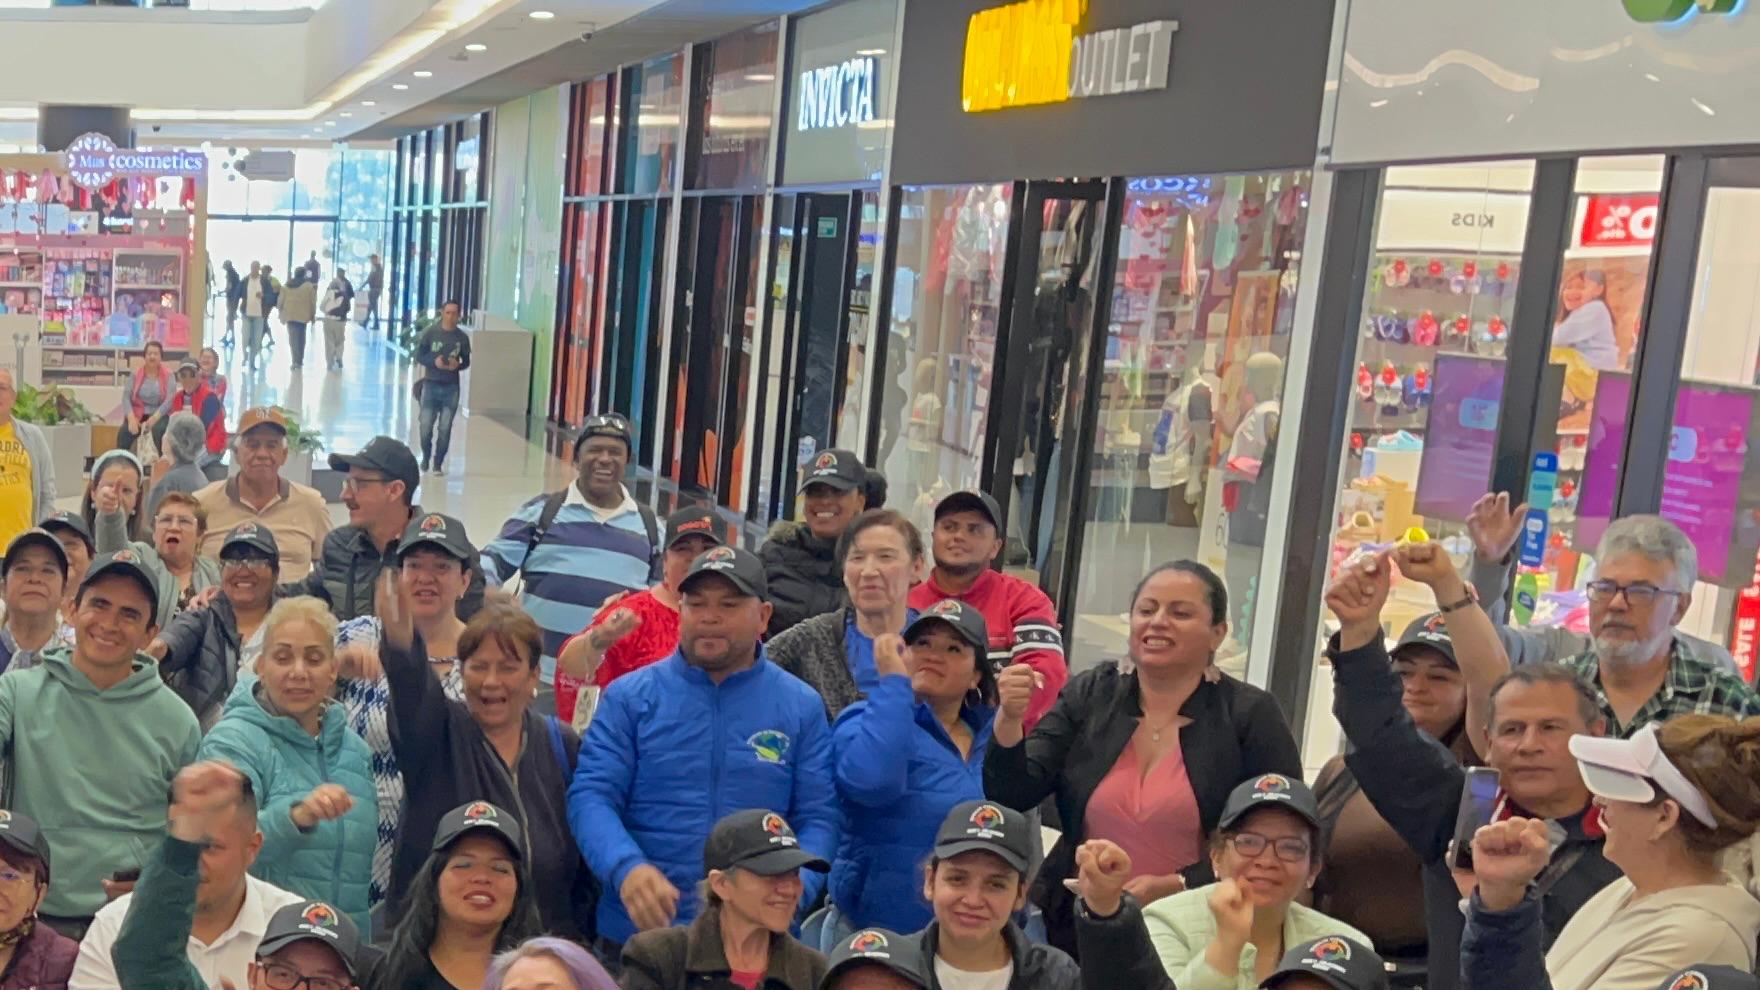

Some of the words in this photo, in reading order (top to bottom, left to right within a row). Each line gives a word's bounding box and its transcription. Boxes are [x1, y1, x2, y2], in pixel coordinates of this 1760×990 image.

[798, 57, 873, 131] INVICTA
[1069, 20, 1179, 98] OUTLET
[115, 153, 203, 169] cosmetics
